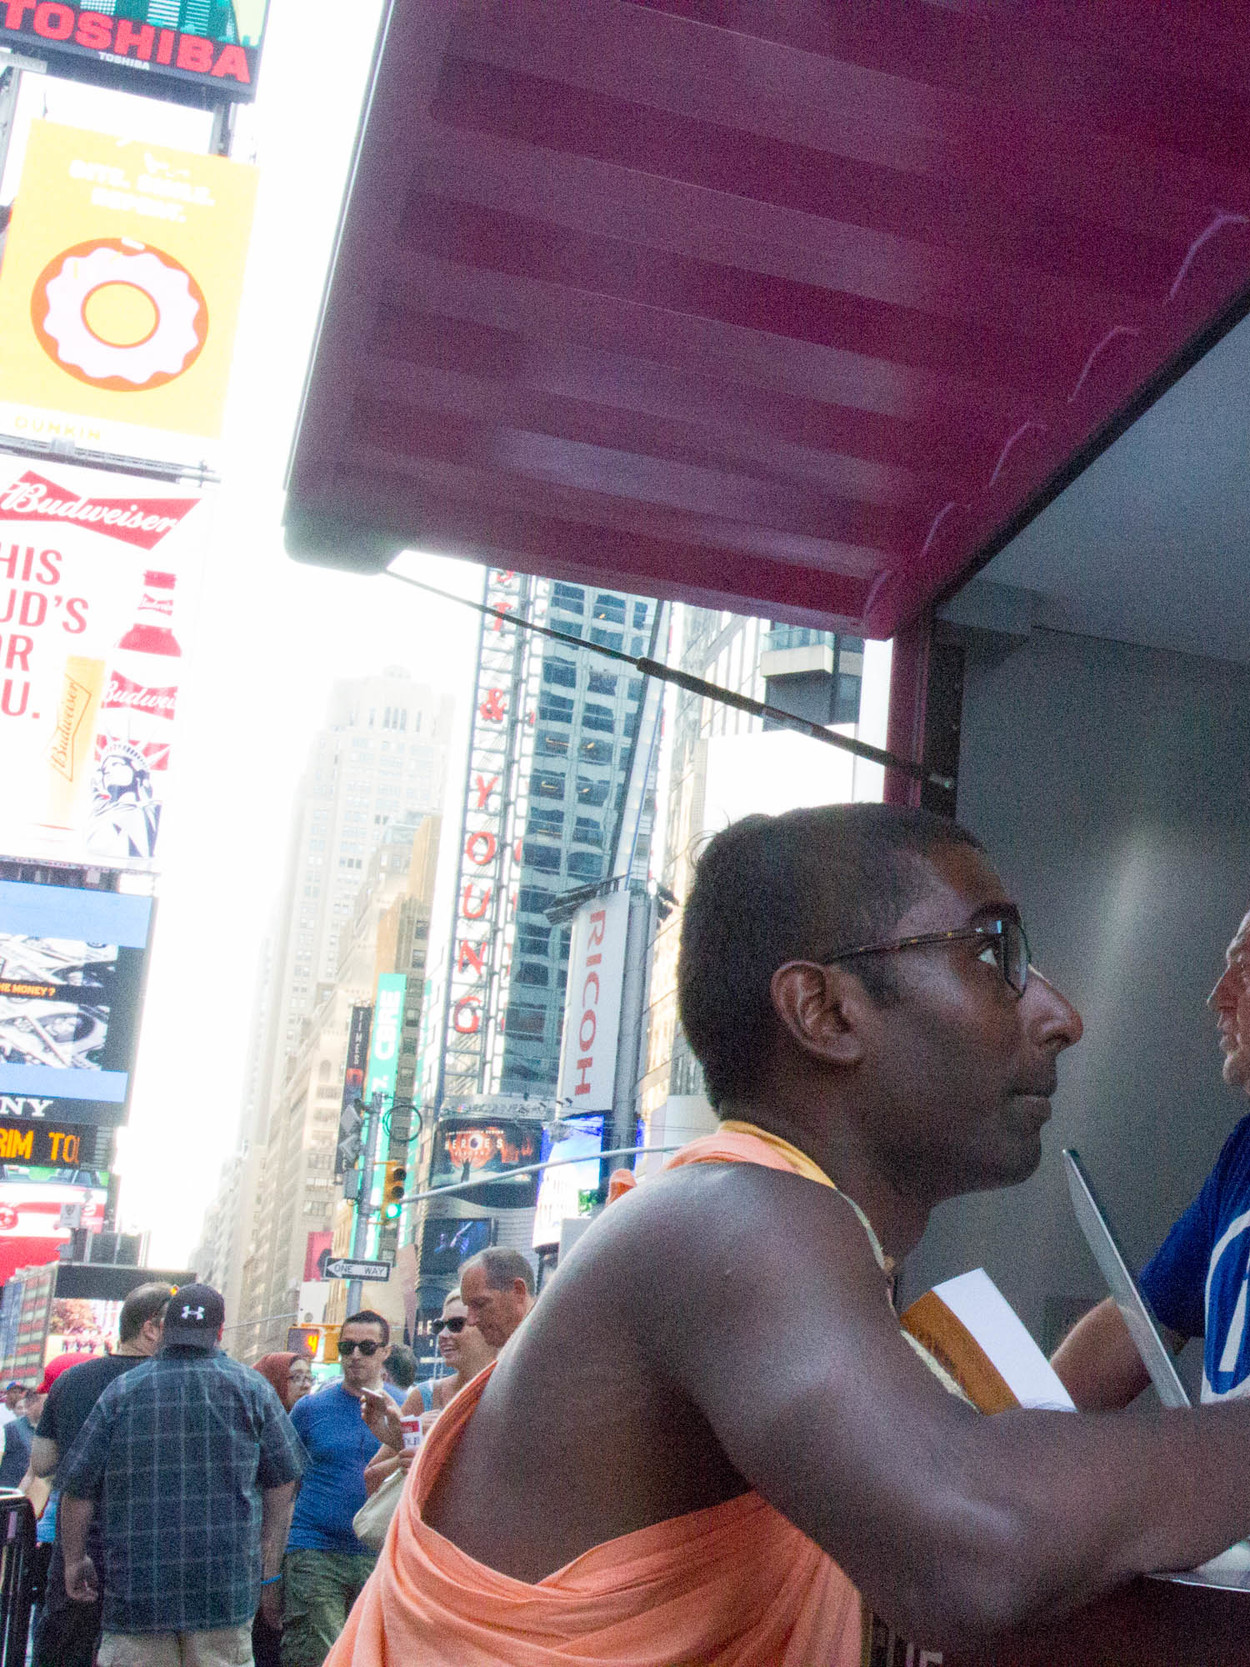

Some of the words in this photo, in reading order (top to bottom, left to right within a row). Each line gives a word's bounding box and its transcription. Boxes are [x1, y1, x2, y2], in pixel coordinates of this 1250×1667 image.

[2, 0, 251, 84] TOSHIBA
[98, 51, 151, 71] TOSHIBA
[0, 481, 179, 533] Budweiser
[0, 633, 34, 673] R
[480, 688, 507, 721] &
[454, 775, 499, 1033] YOUNG
[374, 990, 401, 1060] CBRE
[573, 909, 607, 1097] RICOH
[334, 1263, 353, 1276] ONE
[364, 1265, 385, 1278] WAY
